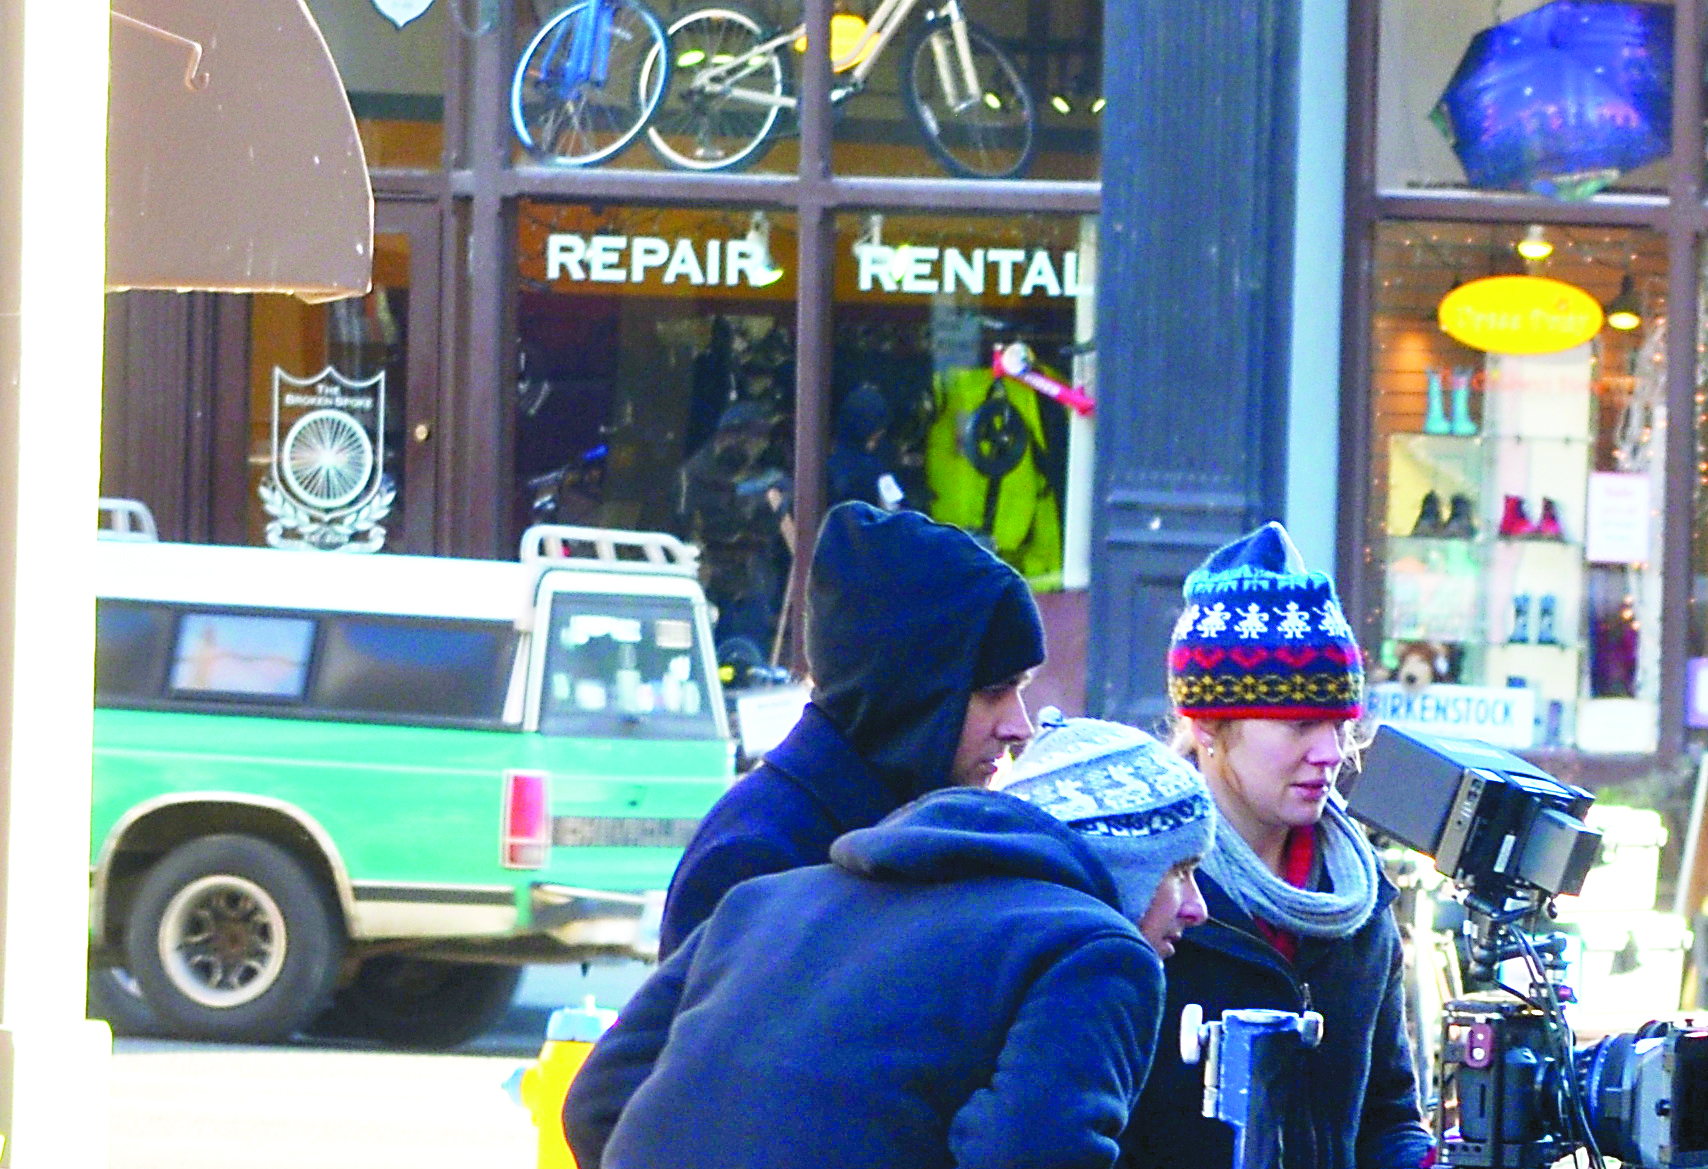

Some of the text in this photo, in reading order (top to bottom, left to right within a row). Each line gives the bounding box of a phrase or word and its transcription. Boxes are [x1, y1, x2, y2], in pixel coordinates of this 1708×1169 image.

[547, 233, 770, 287] REPAIR
[858, 244, 1094, 297] RENTAL
[1367, 691, 1516, 727] BIRKENSTOCK
